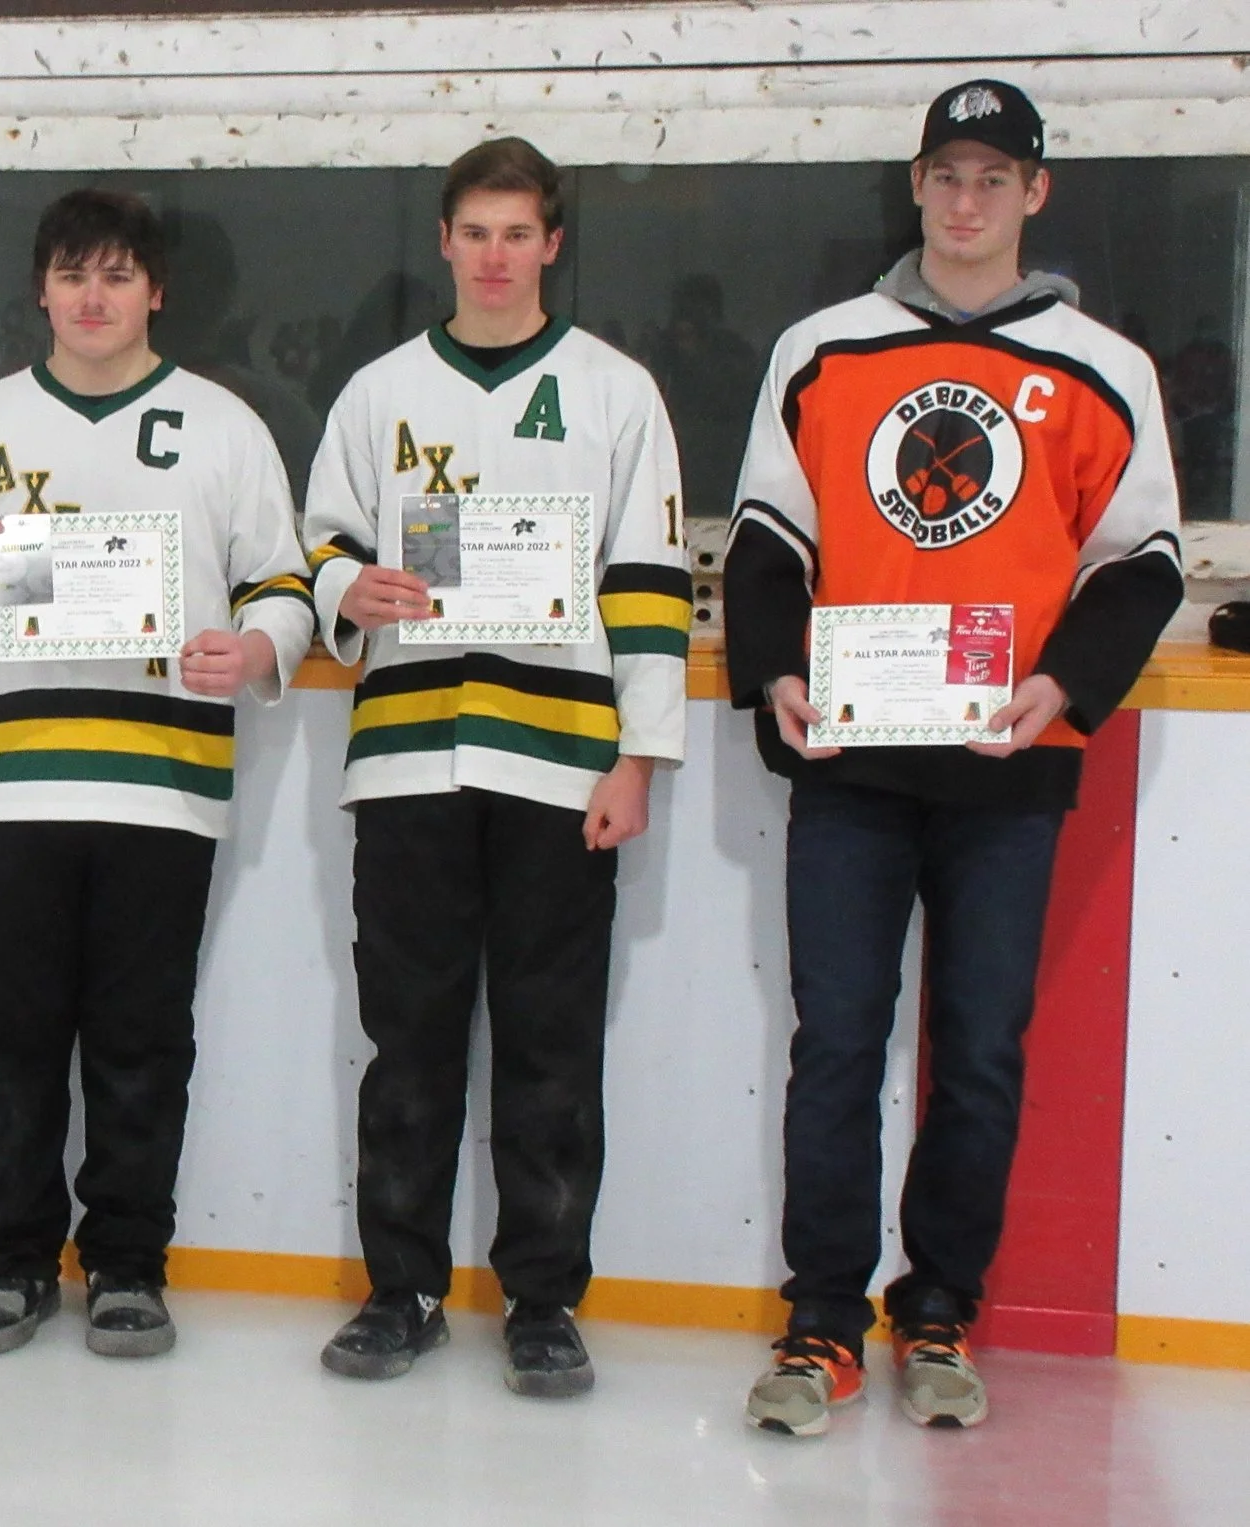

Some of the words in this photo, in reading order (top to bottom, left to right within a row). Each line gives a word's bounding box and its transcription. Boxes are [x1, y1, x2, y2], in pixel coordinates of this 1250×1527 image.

[513, 373, 567, 443] A
[895, 386, 1006, 432] DEBDEN
[1013, 373, 1056, 424] C
[136, 407, 184, 471] C
[663, 493, 687, 548] 1
[55, 560, 78, 569] STAR
[80, 559, 116, 569] AWARD
[118, 559, 141, 568] 2022
[460, 542, 484, 552] STAR
[487, 542, 524, 552] AWARD
[527, 542, 550, 552] 2022
[854, 649, 872, 659] ALL
[874, 649, 898, 658] STAR
[901, 648, 940, 658] AWARD
